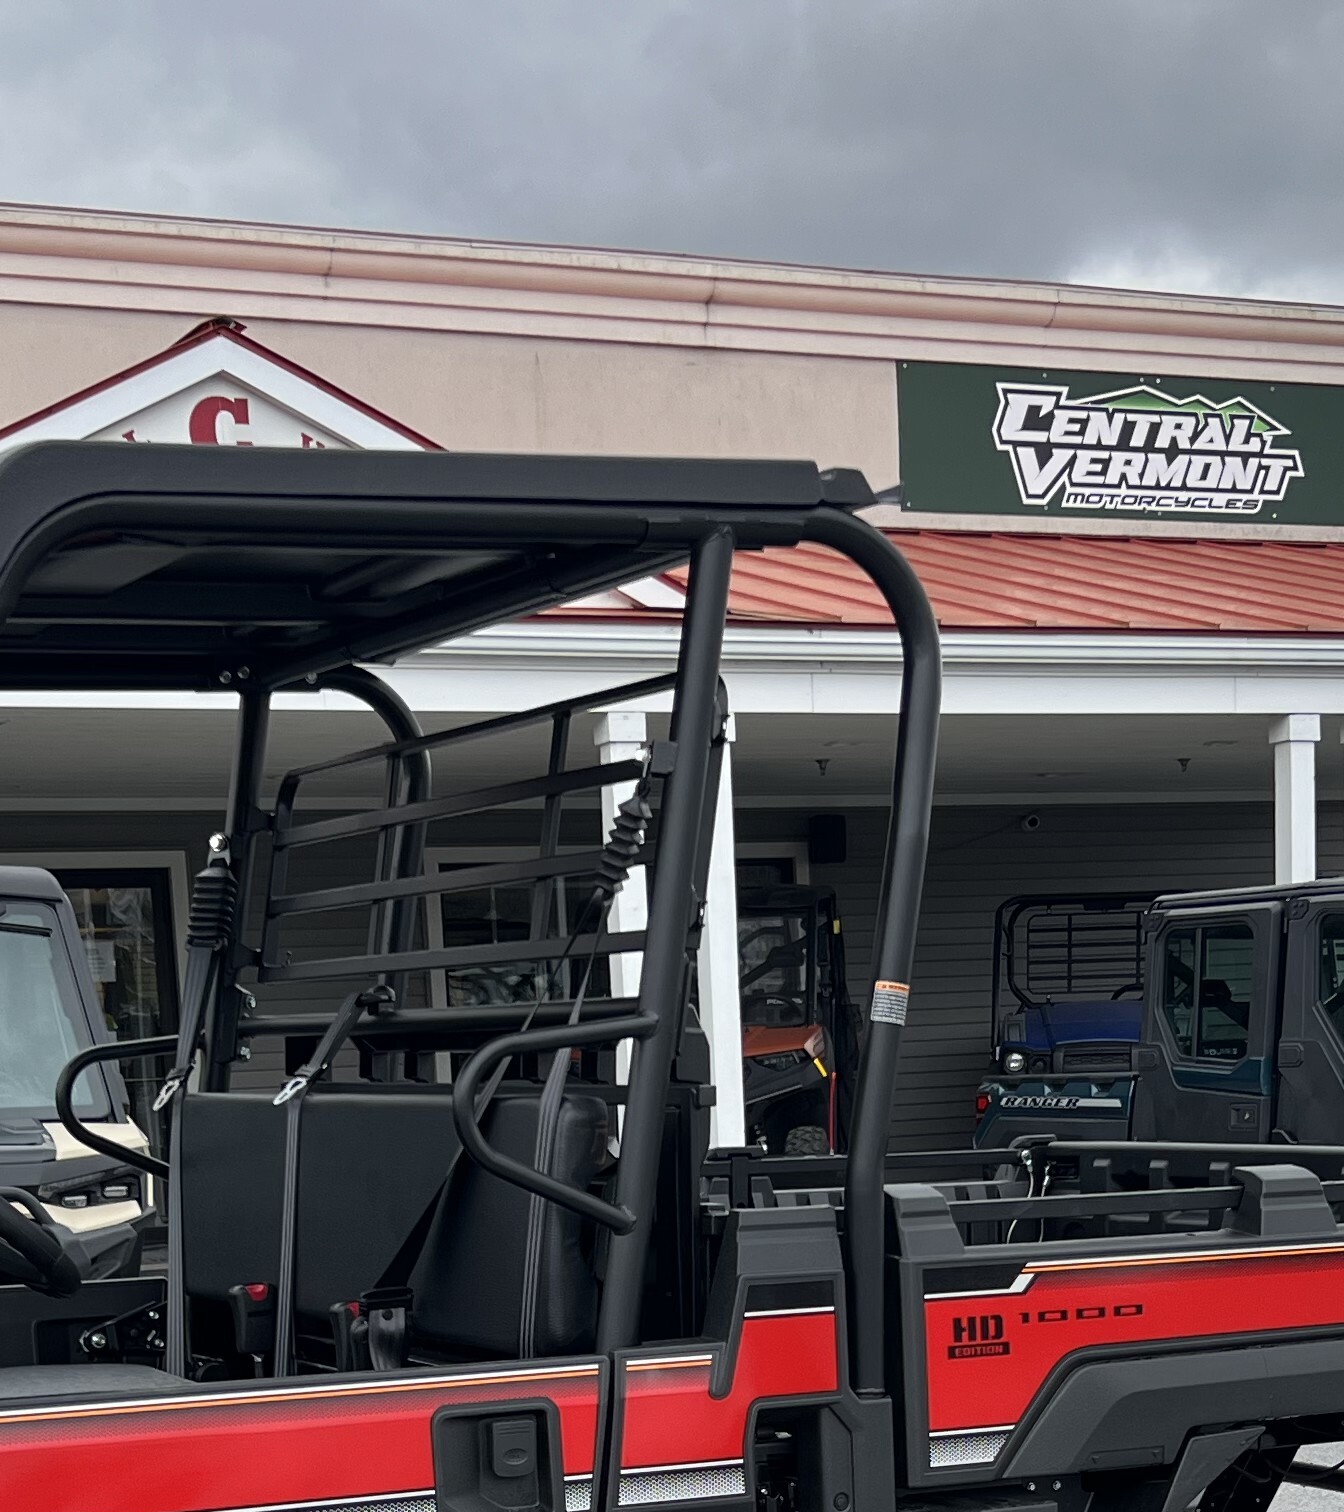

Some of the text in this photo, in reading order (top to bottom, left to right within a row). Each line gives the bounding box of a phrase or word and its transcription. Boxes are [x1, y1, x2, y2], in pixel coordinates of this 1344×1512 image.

[1000, 392, 1268, 452] CENTRAL
[1015, 445, 1295, 497] VERMONT
[1066, 490, 1260, 511] MOTORCYCLES
[1003, 1096, 1080, 1109] RANGER
[1019, 1304, 1144, 1324] 1000
[952, 1314, 1003, 1343] HD
[954, 1344, 1004, 1357] EDITION
